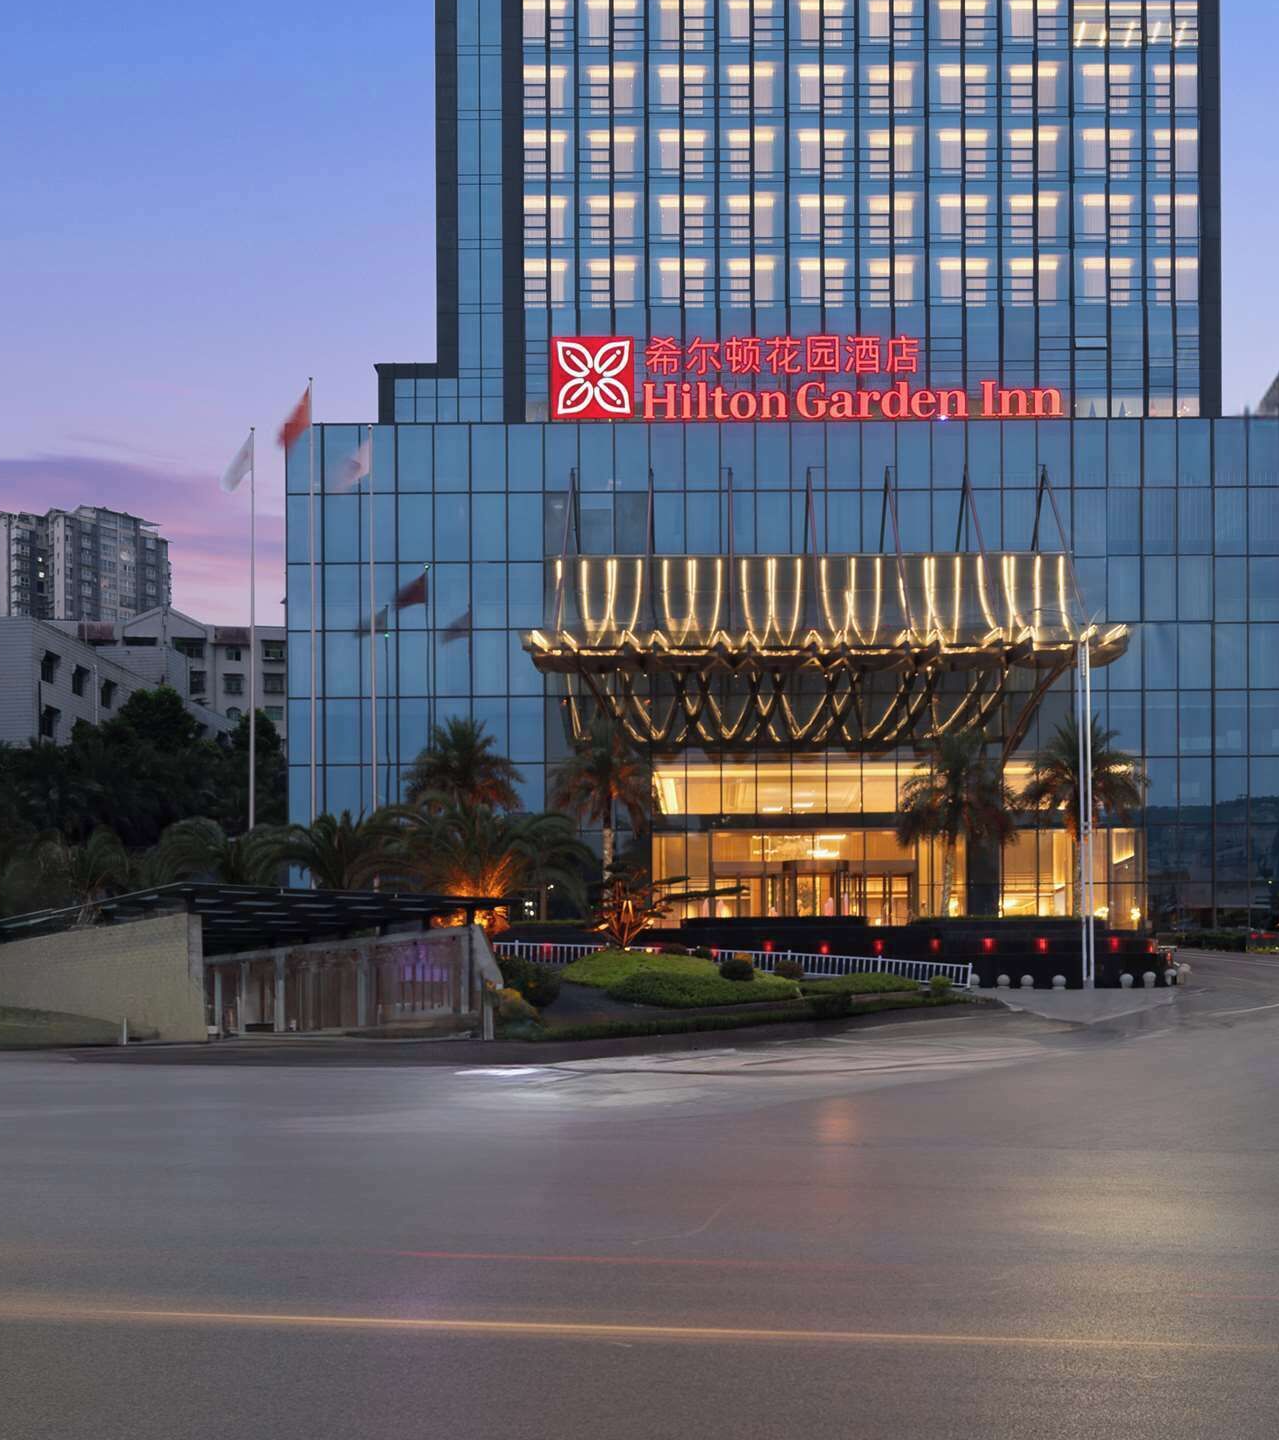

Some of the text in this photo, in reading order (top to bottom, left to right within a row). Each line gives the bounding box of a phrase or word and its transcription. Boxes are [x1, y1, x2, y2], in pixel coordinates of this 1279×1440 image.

[644, 335, 920, 375] 希尔顿花园酒店
[642, 380, 1064, 420] Hilton Garden Inn
